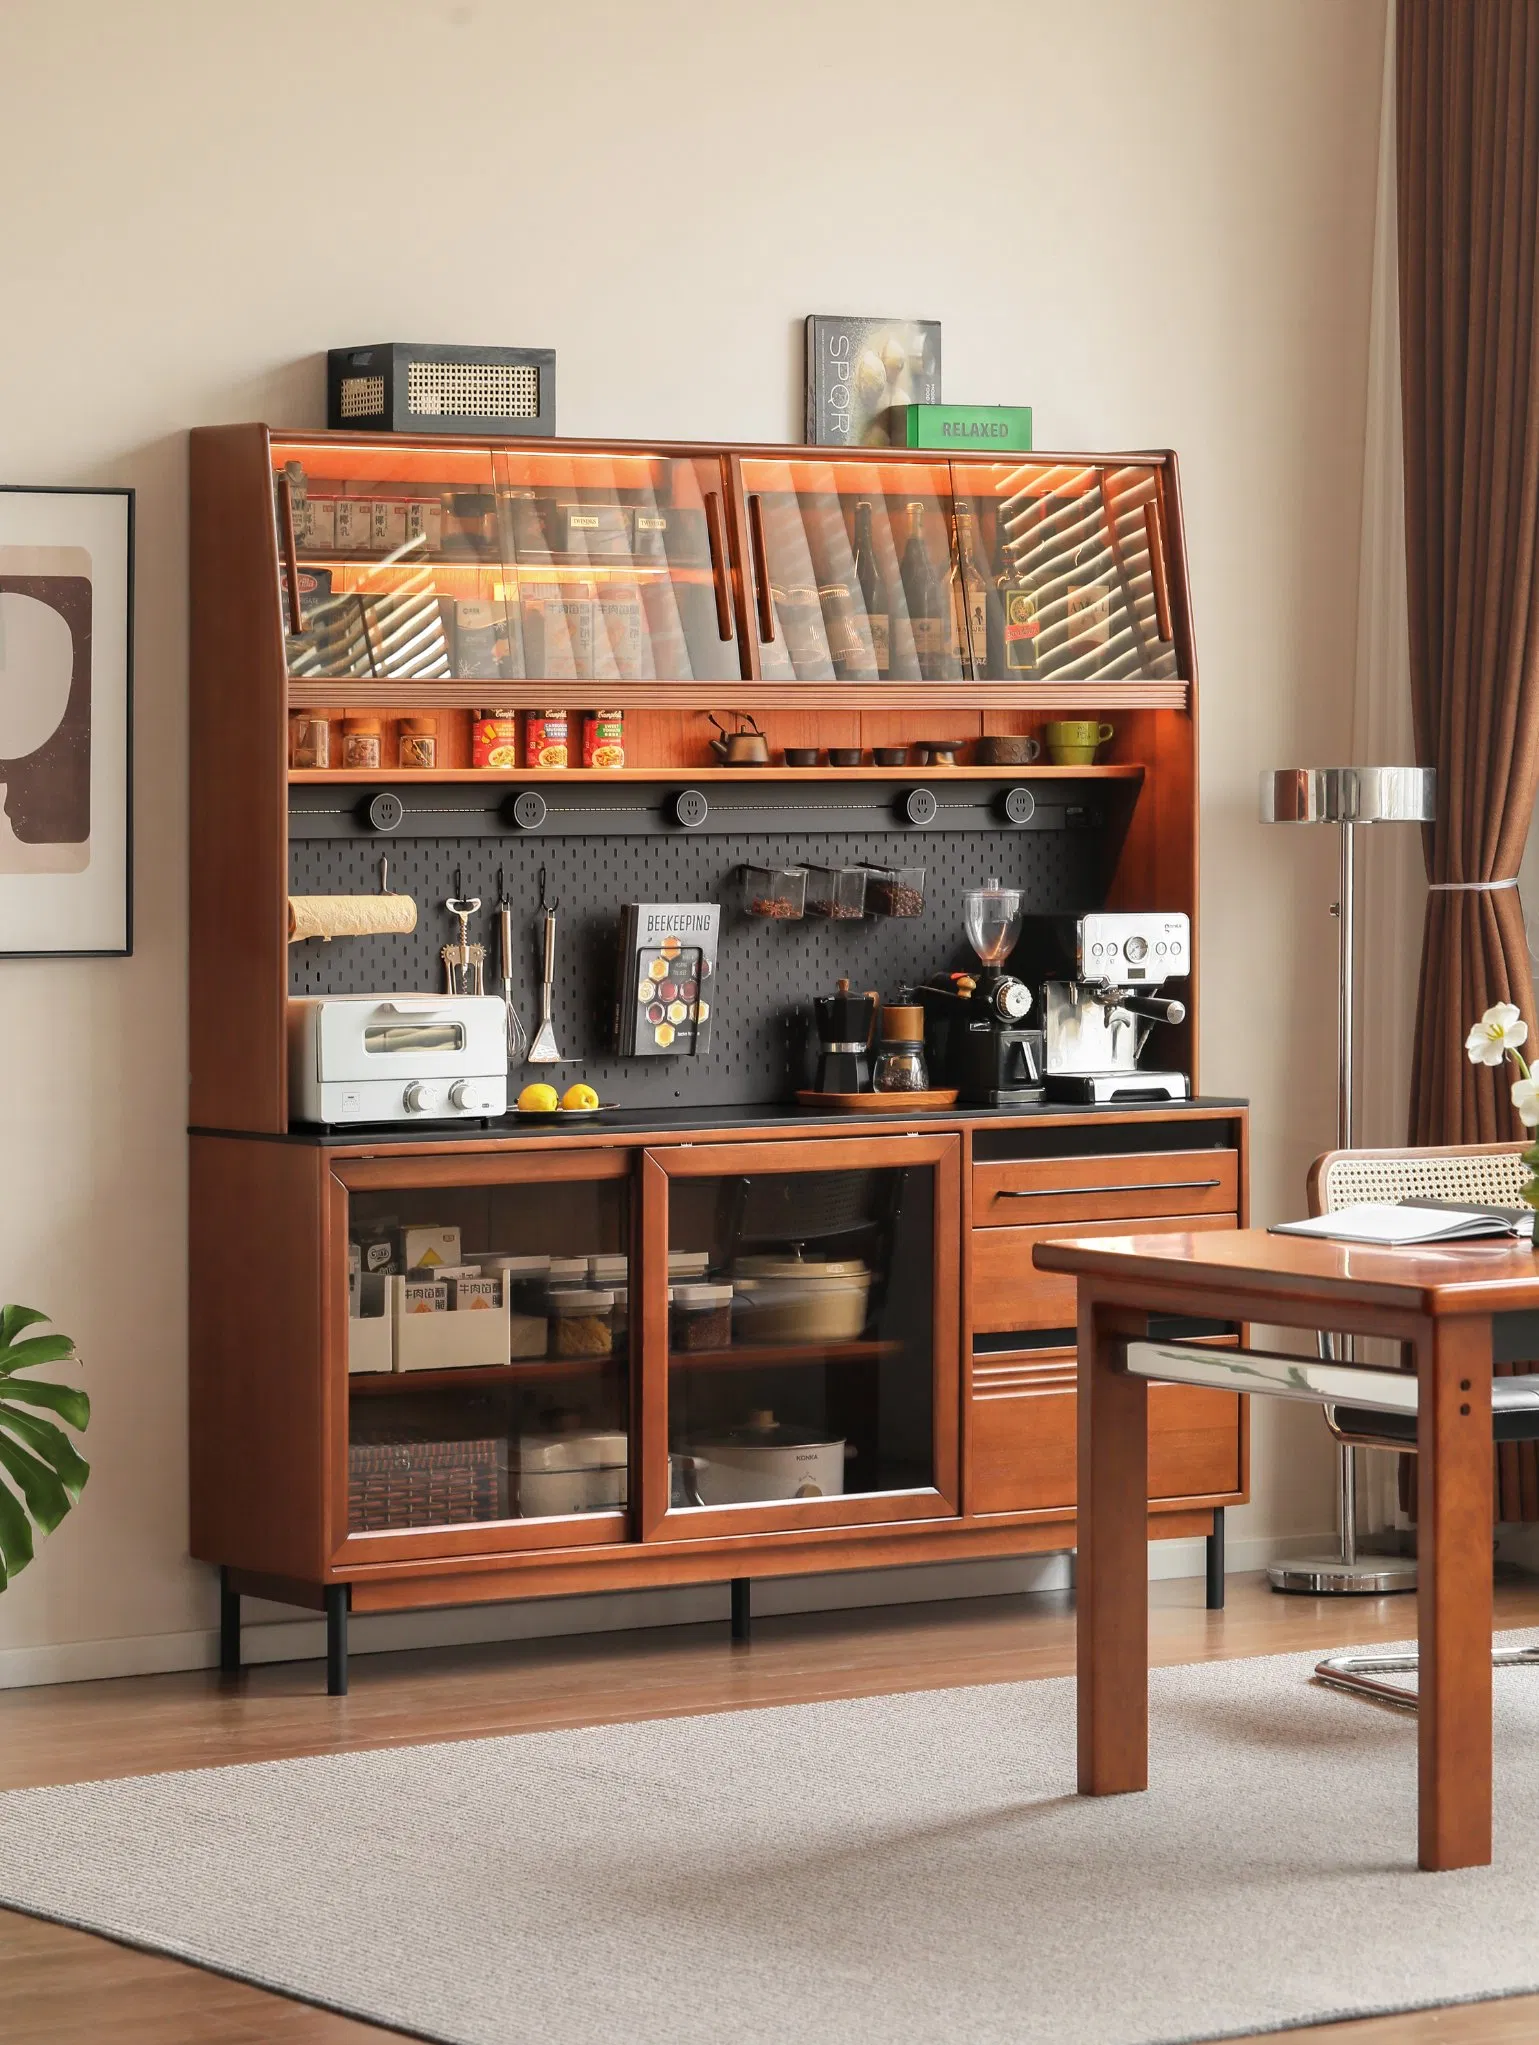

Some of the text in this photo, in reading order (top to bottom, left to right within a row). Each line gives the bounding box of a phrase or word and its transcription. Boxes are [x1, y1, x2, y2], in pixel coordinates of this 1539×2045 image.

[828, 335, 849, 433] SPQR
[942, 422, 1009, 438] RELAXED
[647, 914, 711, 932] BEEKEEPING
